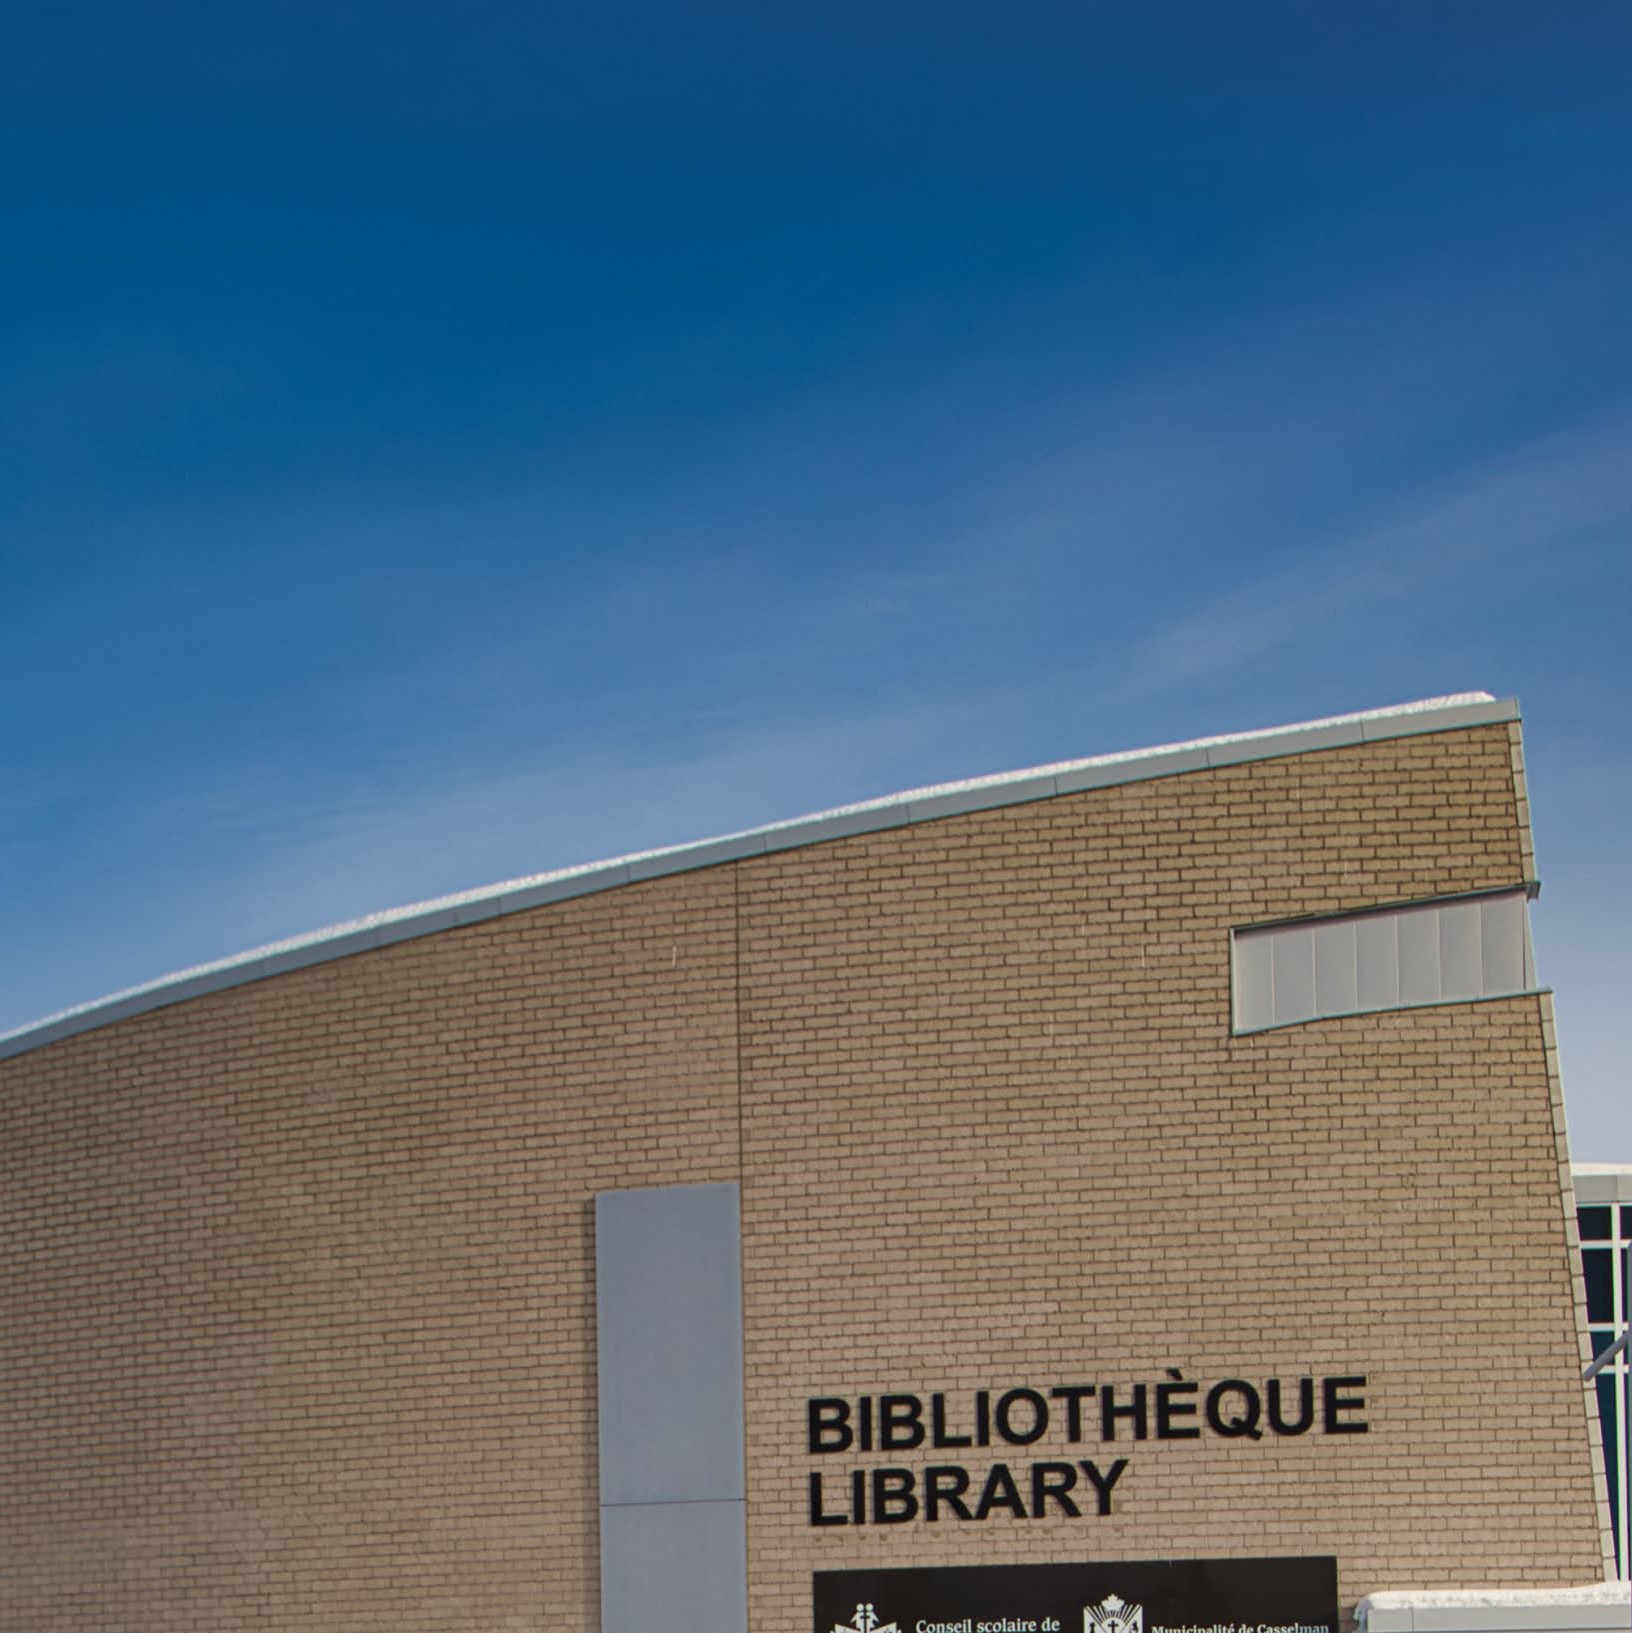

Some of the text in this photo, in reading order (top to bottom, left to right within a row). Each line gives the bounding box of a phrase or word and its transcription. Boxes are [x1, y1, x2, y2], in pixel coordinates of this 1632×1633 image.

[807, 1368, 1369, 1454] BIBLIOTHÈQUE
[809, 1459, 1130, 1527] LIBRARY
[976, 1617, 1037, 1633] scolaire
[1041, 1617, 1061, 1632] de
